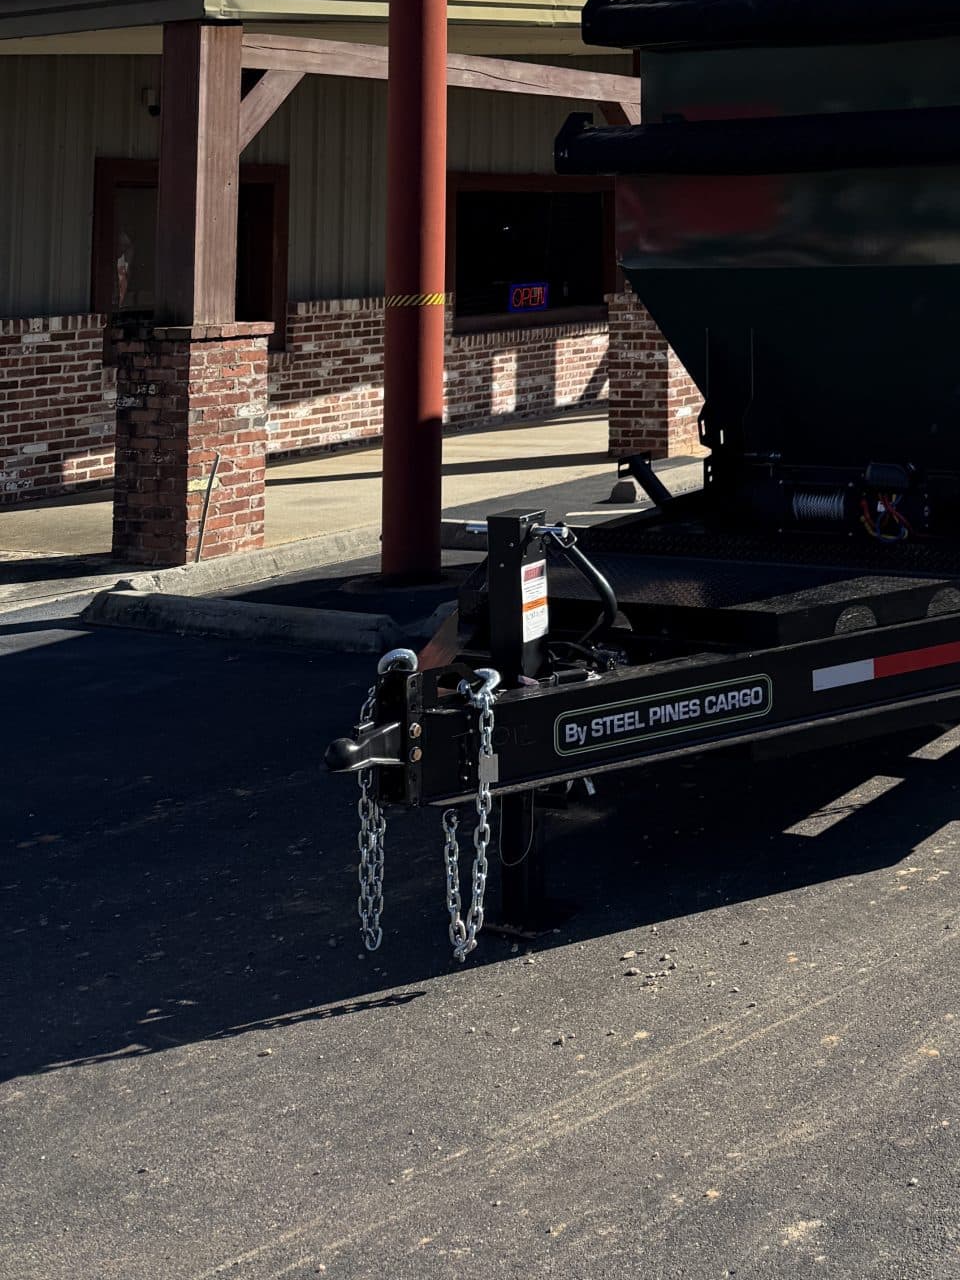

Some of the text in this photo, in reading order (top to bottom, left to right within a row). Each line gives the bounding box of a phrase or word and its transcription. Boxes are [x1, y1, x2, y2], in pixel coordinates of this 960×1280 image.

[512, 286, 545, 307] OPEN
[565, 723, 587, 745] By
[591, 711, 645, 737] STEEL
[649, 699, 700, 726] PINES
[704, 686, 763, 714] CARGO
